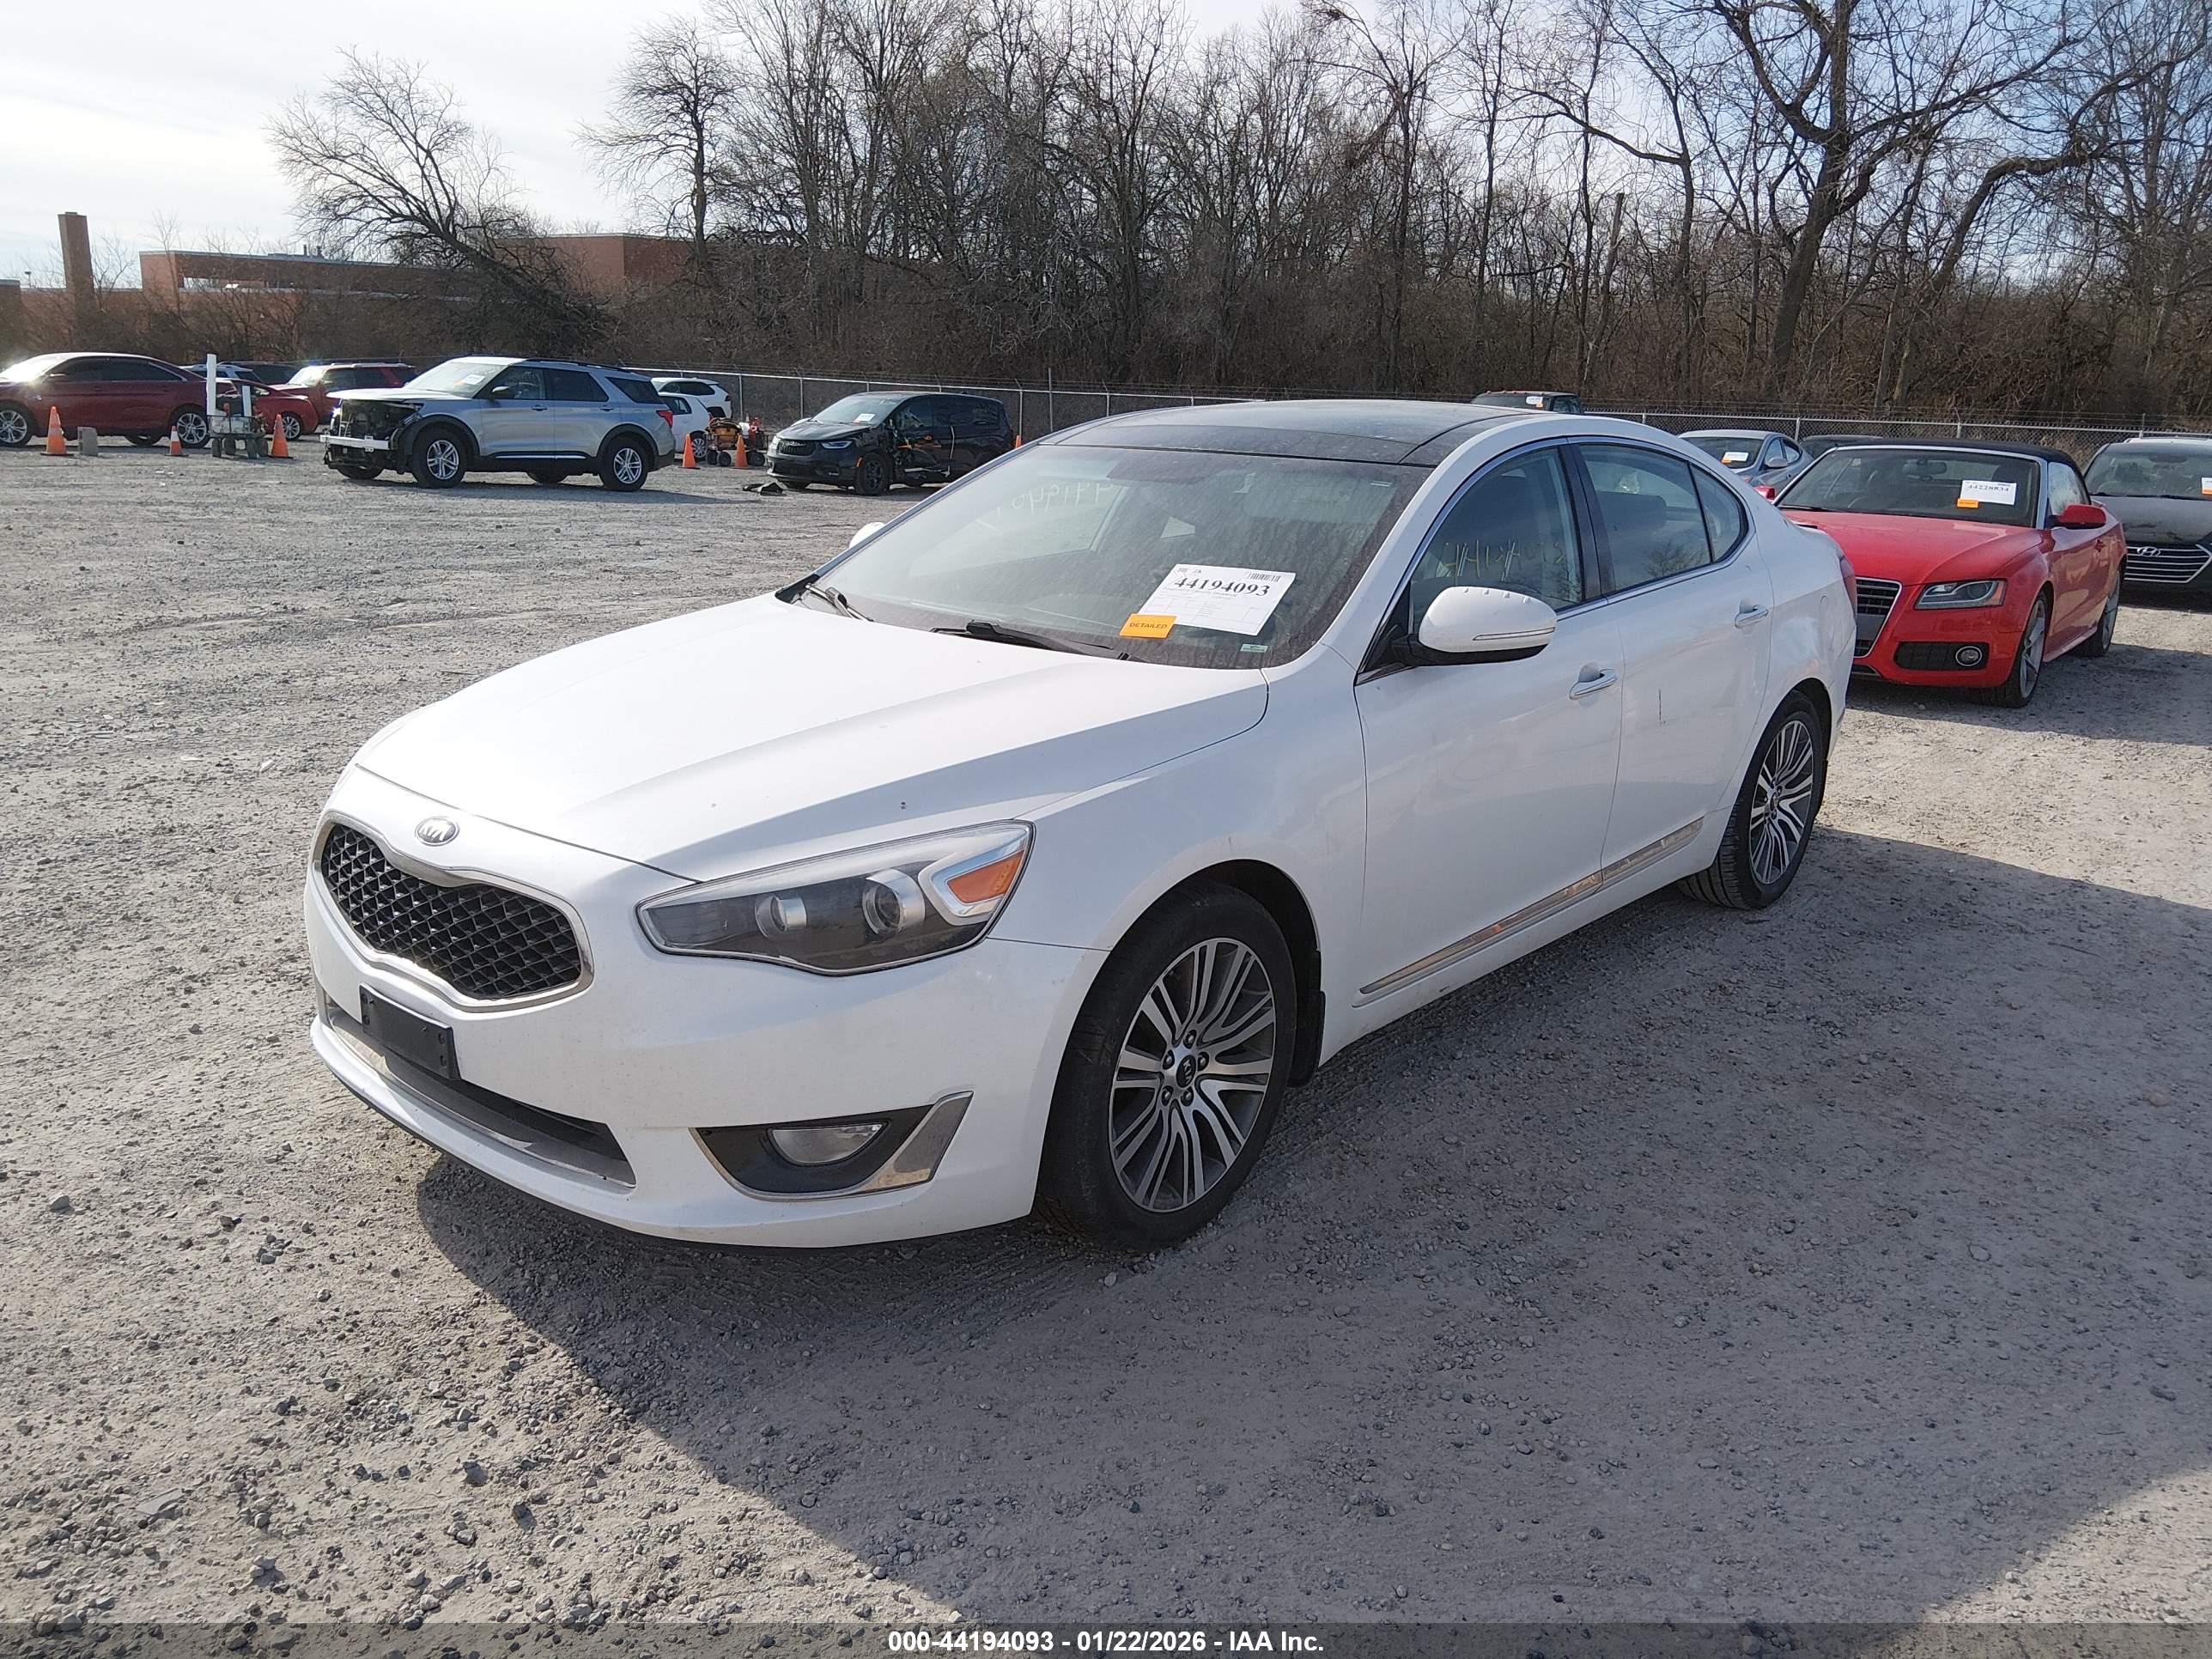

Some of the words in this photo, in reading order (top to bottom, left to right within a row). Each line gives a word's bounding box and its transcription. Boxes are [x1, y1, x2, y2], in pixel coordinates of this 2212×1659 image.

[1173, 576, 1271, 597] 44194093
[1129, 622, 1169, 630] DETAILED
[418, 822, 452, 842] KIA
